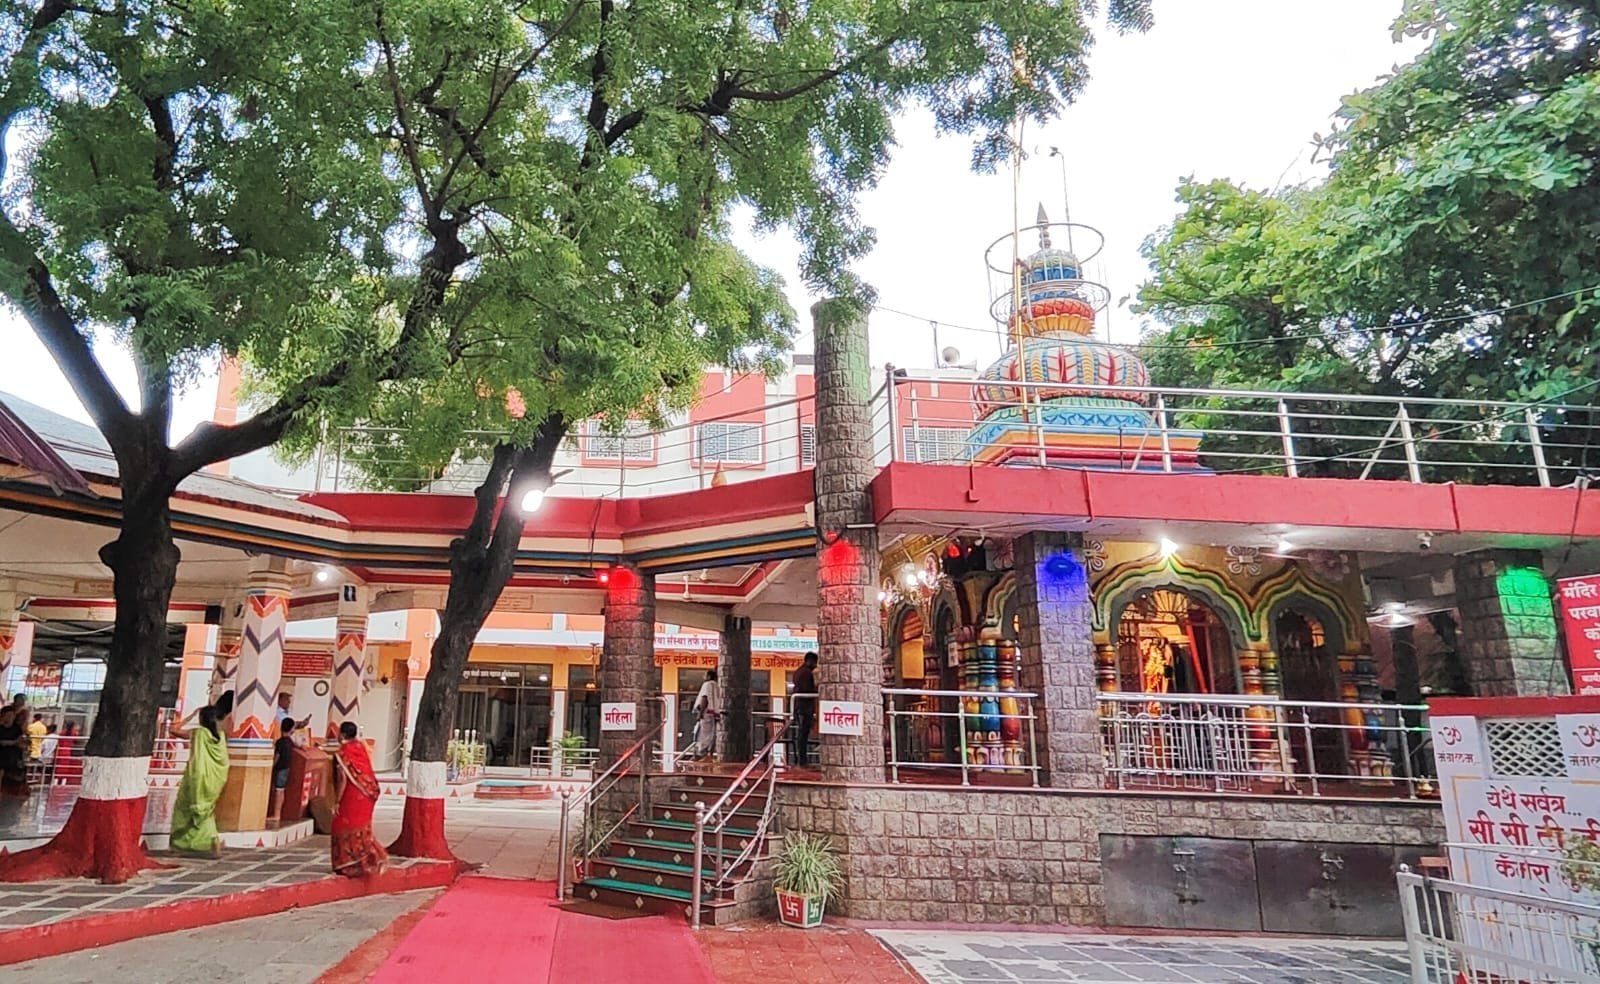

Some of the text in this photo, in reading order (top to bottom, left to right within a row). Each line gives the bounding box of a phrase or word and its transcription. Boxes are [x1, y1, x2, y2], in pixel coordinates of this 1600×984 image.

[1562, 582, 1597, 598] मंदिर
[604, 707, 633, 725] महिला
[823, 706, 860, 728] महिला
[1486, 785, 1517, 811] येथे
